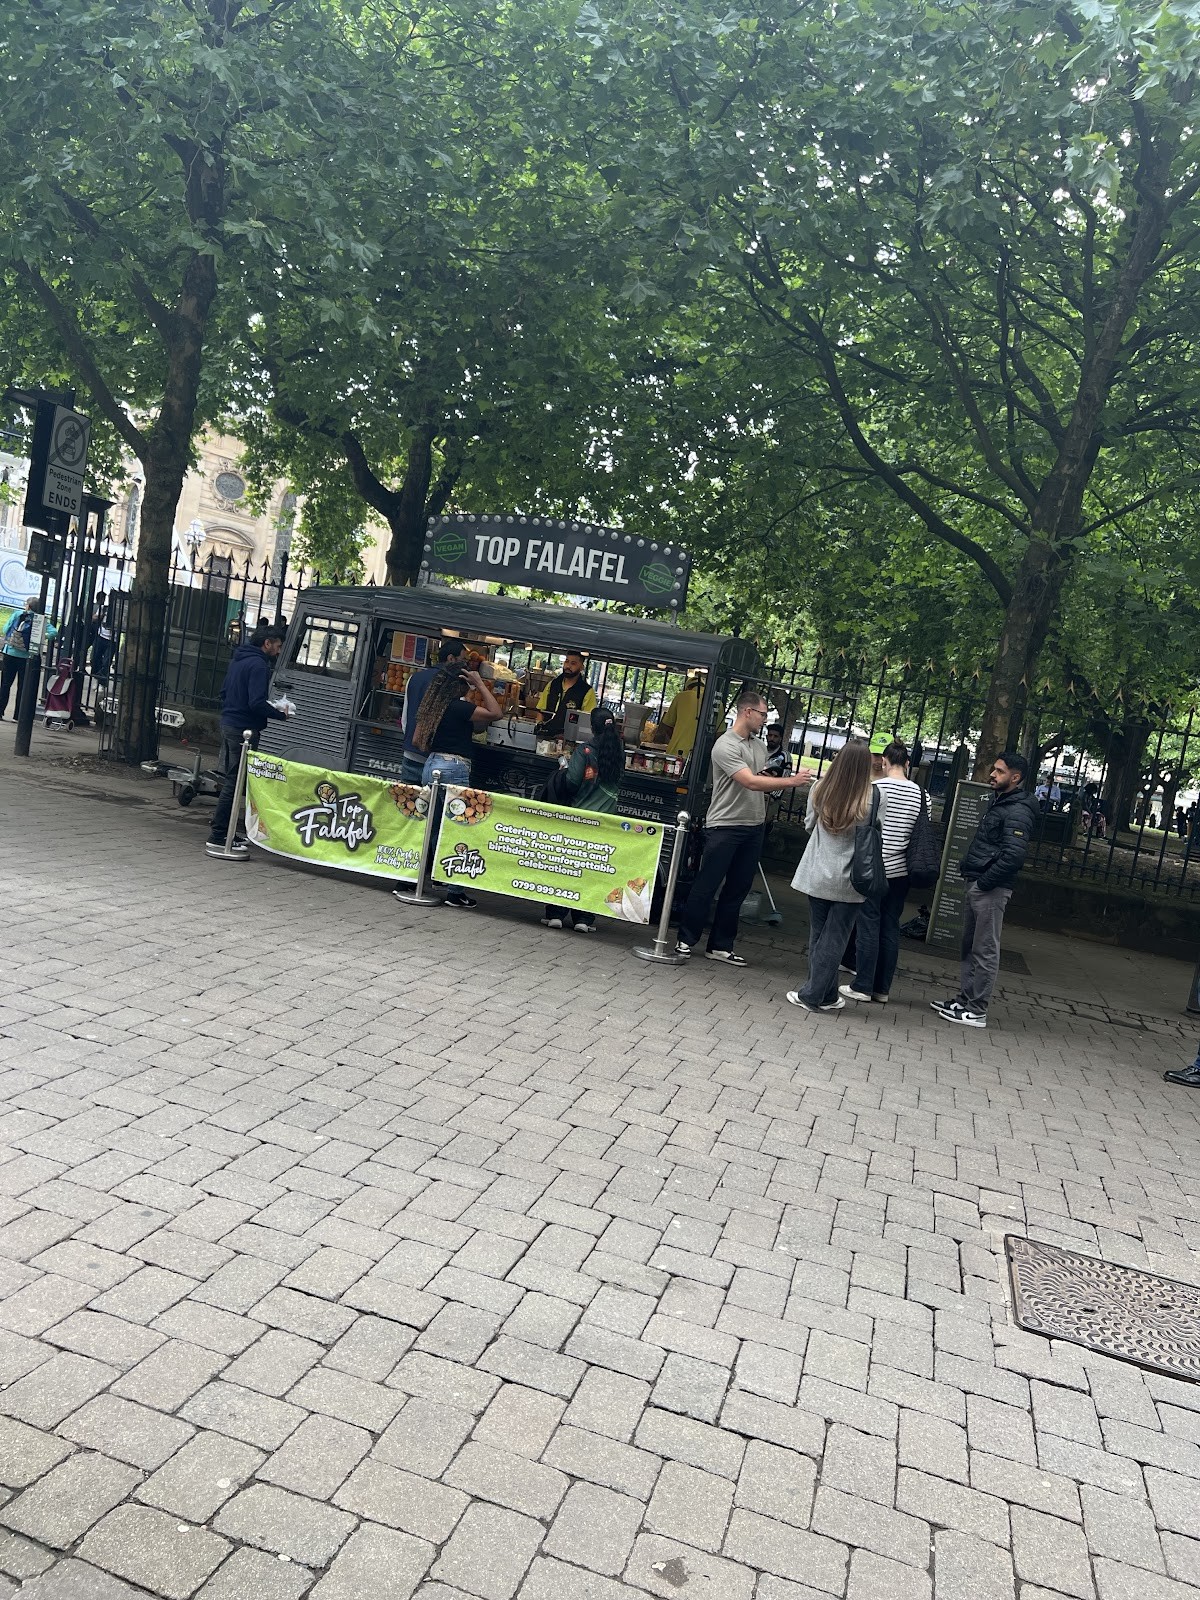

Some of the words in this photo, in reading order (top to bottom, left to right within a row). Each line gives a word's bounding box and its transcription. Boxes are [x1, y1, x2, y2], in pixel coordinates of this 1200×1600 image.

[49, 468, 82, 487] Pedestrian
[56, 482, 72, 494] Zone
[48, 492, 76, 510] ENDS
[436, 542, 465, 553] VEGAN
[474, 534, 521, 566] TOP
[524, 540, 629, 584] FALAFEL
[643, 569, 673, 587] VEGGIE
[248, 764, 287, 782] Vegetarian
[254, 757, 276, 770] Vegan
[368, 759, 402, 774] FALAFE
[338, 796, 364, 818] Top
[518, 805, 600, 827] www.top-falafel.com
[294, 807, 372, 849] Falafel
[494, 823, 538, 841] Catering
[538, 832, 549, 842] to
[550, 832, 562, 844] all
[563, 837, 586, 851] your
[586, 841, 616, 855] party
[498, 834, 529, 848] needs,
[530, 840, 554, 853] from
[555, 845, 587, 858] events
[589, 850, 608, 862] and
[375, 855, 401, 869] Healthy
[468, 850, 480, 863] Top
[488, 842, 536, 860] birthdays
[536, 852, 546, 860] to
[548, 854, 616, 874] unforgettable
[442, 857, 485, 878] Falafel
[518, 858, 582, 878] celebrations!
[512, 878, 536, 892] 0799
[536, 884, 554, 896] 999
[555, 888, 580, 901] 2424
